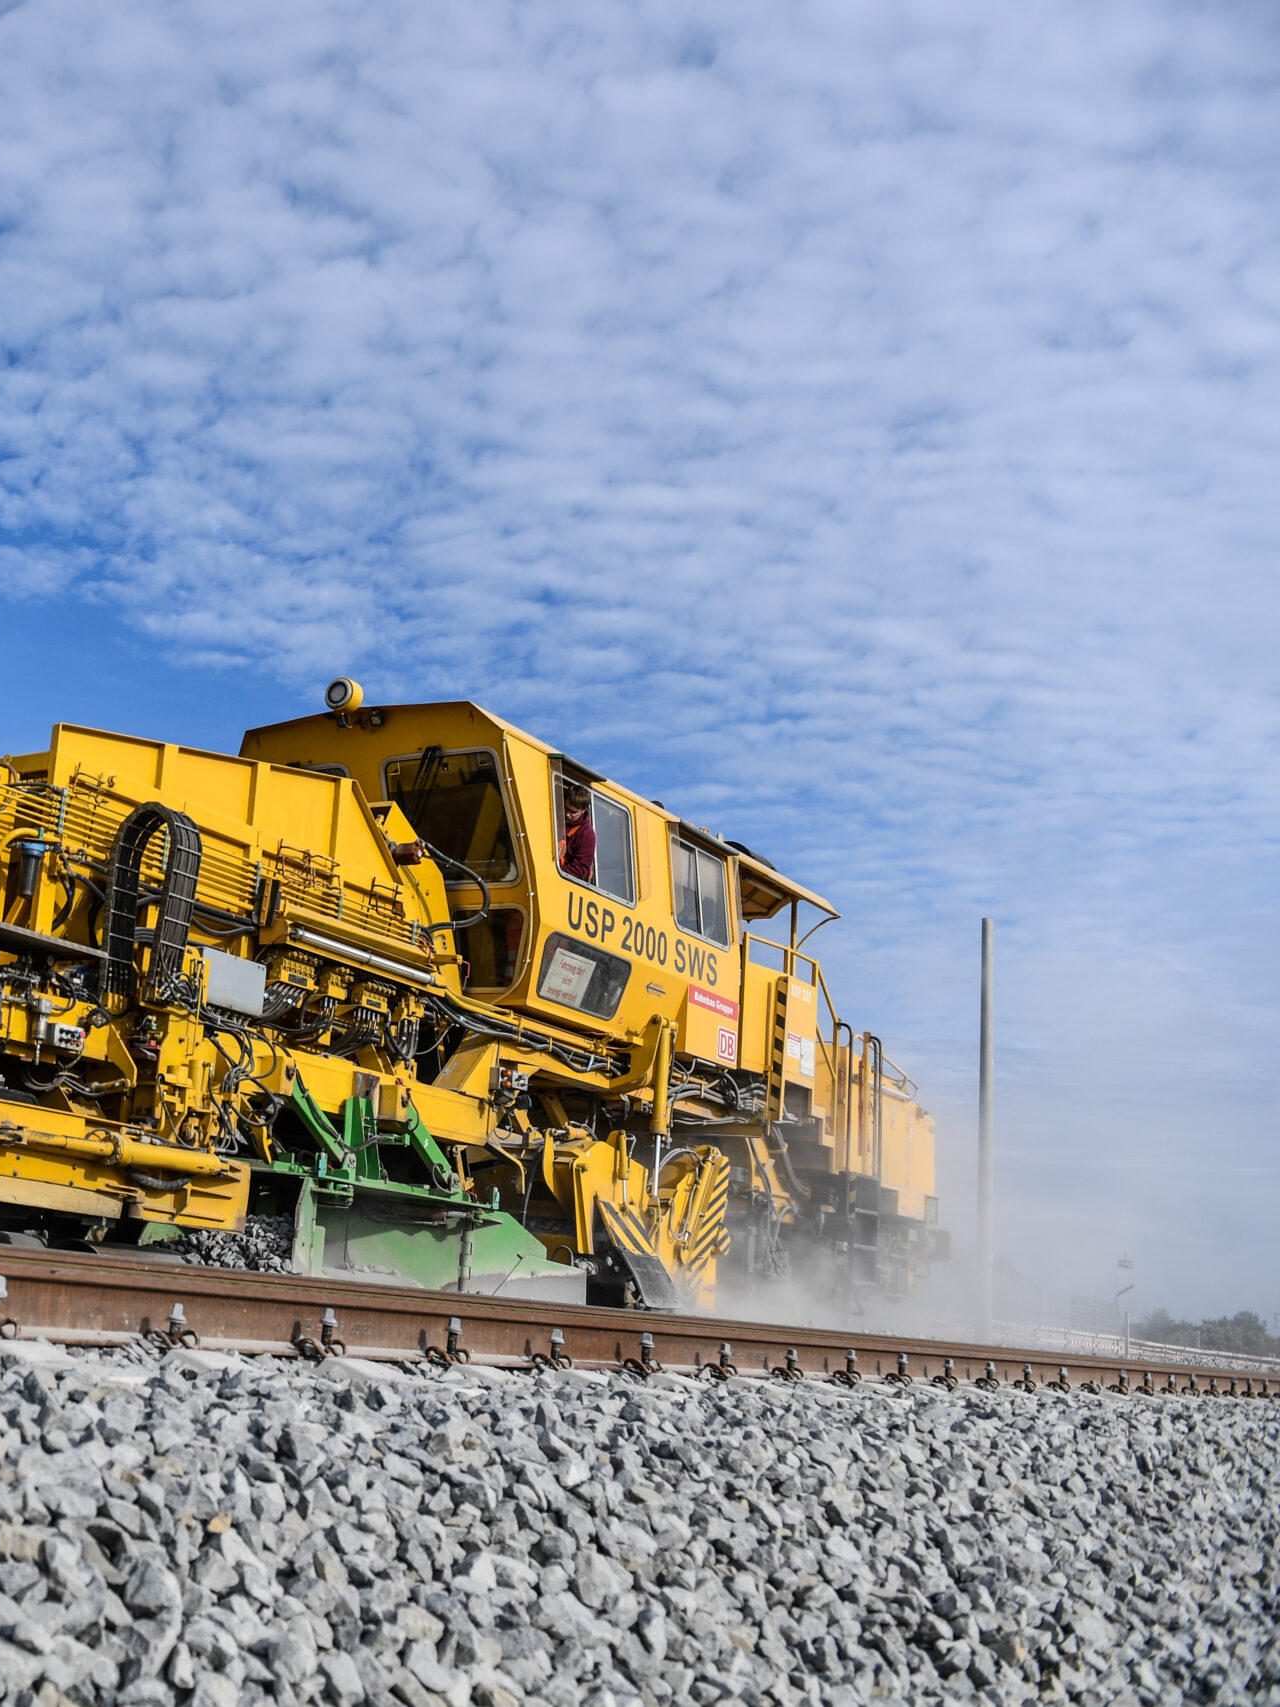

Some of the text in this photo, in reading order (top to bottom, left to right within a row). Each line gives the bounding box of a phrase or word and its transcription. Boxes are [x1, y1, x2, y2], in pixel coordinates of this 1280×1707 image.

[568, 891, 718, 987] USP 2000 SWS
[694, 991, 734, 1015] Bahnbau Gruppe
[719, 1032, 734, 1057] DB
